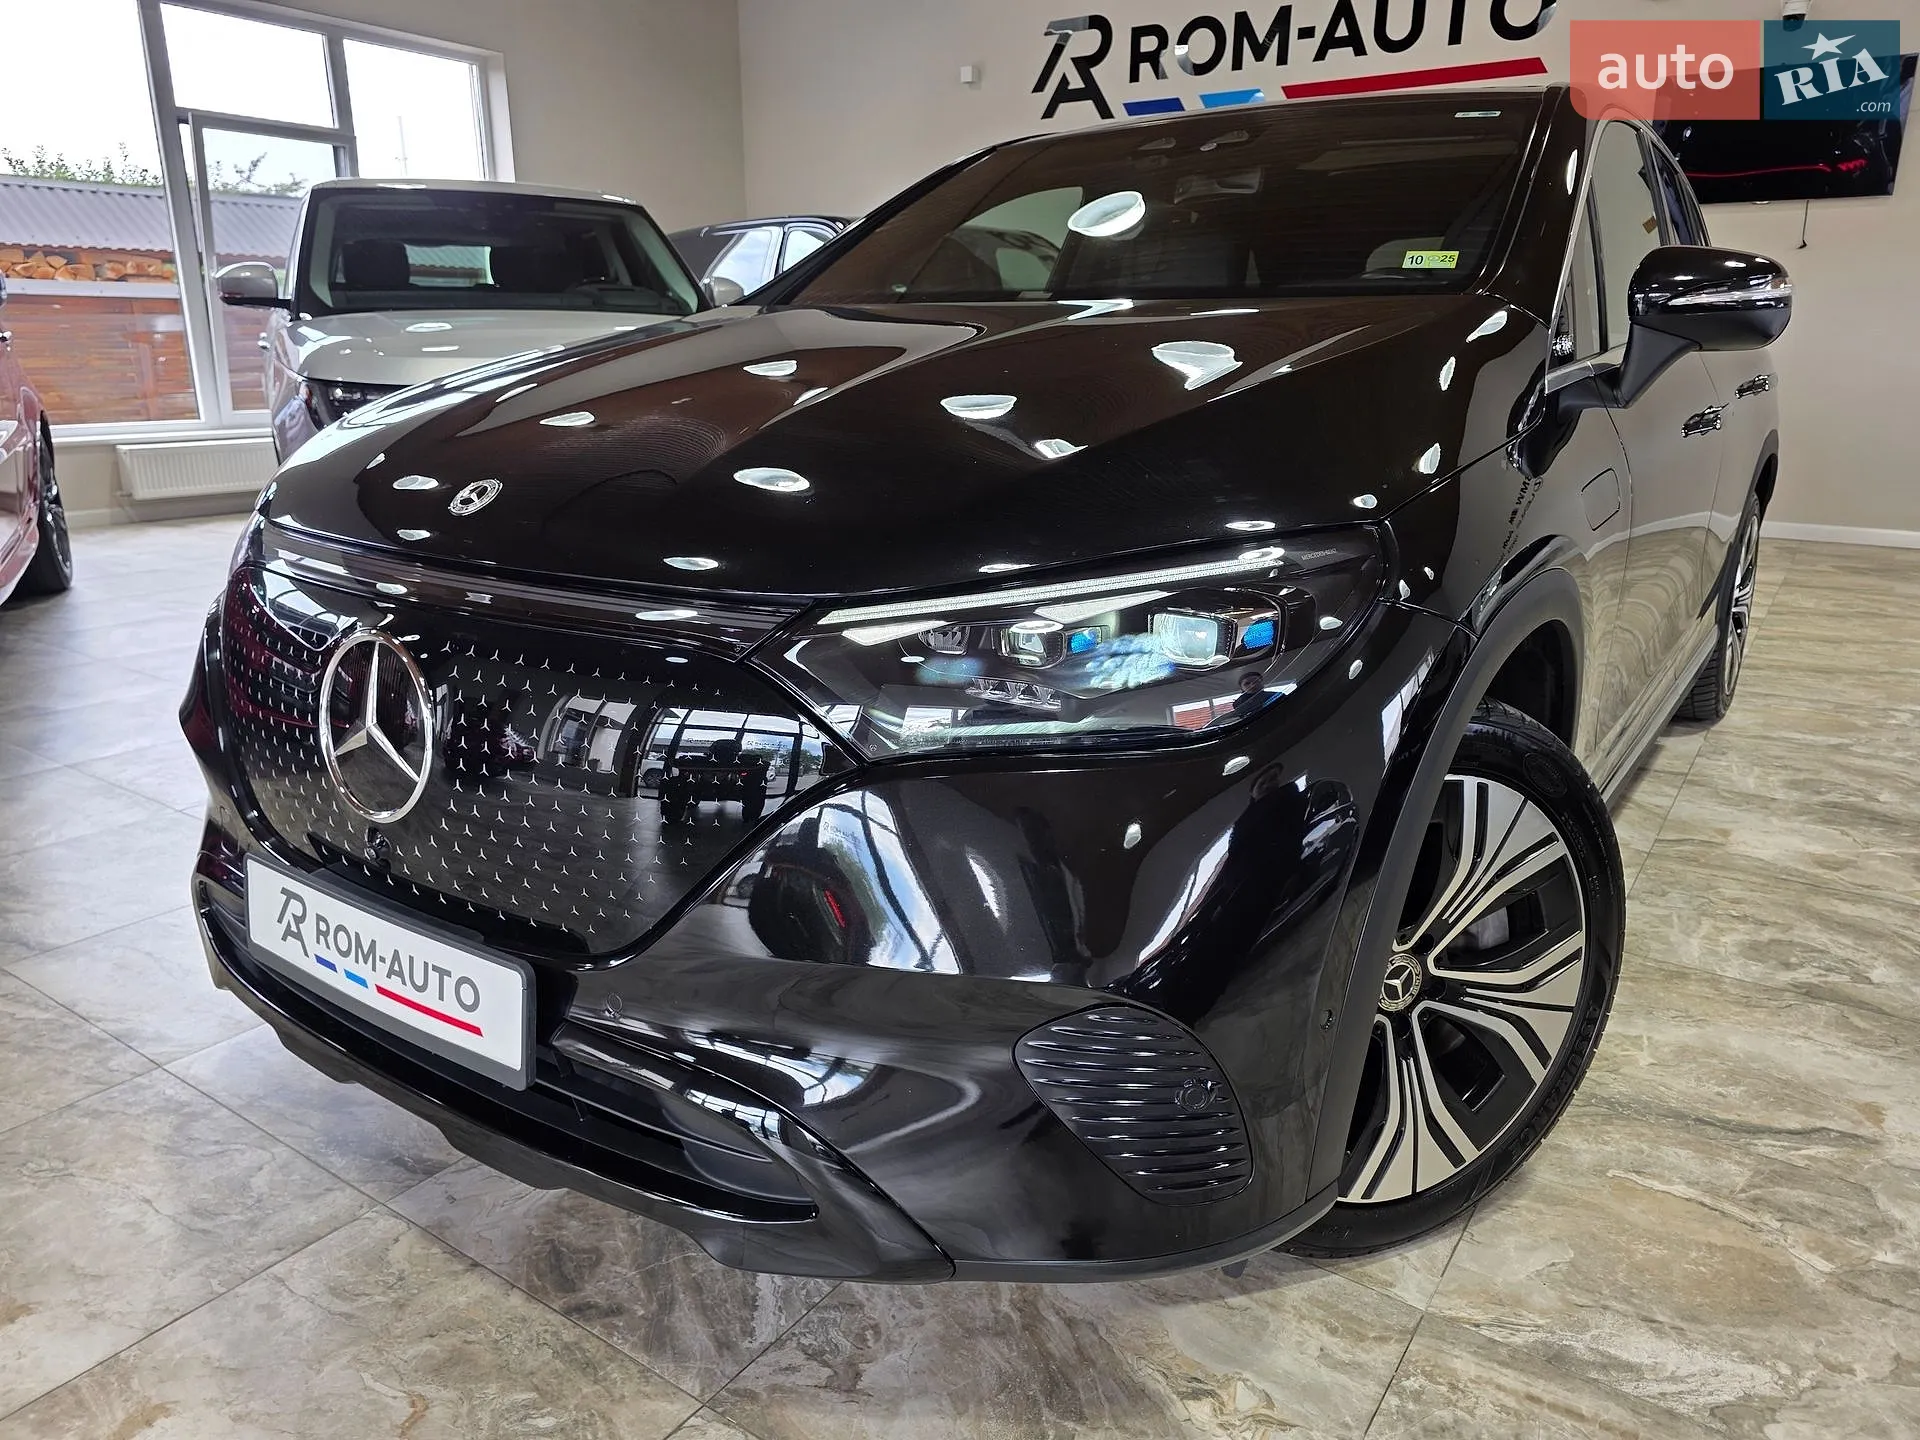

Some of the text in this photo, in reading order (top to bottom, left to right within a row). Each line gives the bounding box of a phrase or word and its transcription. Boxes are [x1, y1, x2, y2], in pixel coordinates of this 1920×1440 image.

[1408, 254, 1456, 265] 10 25
[314, 912, 481, 1013] ROM-AUTO
